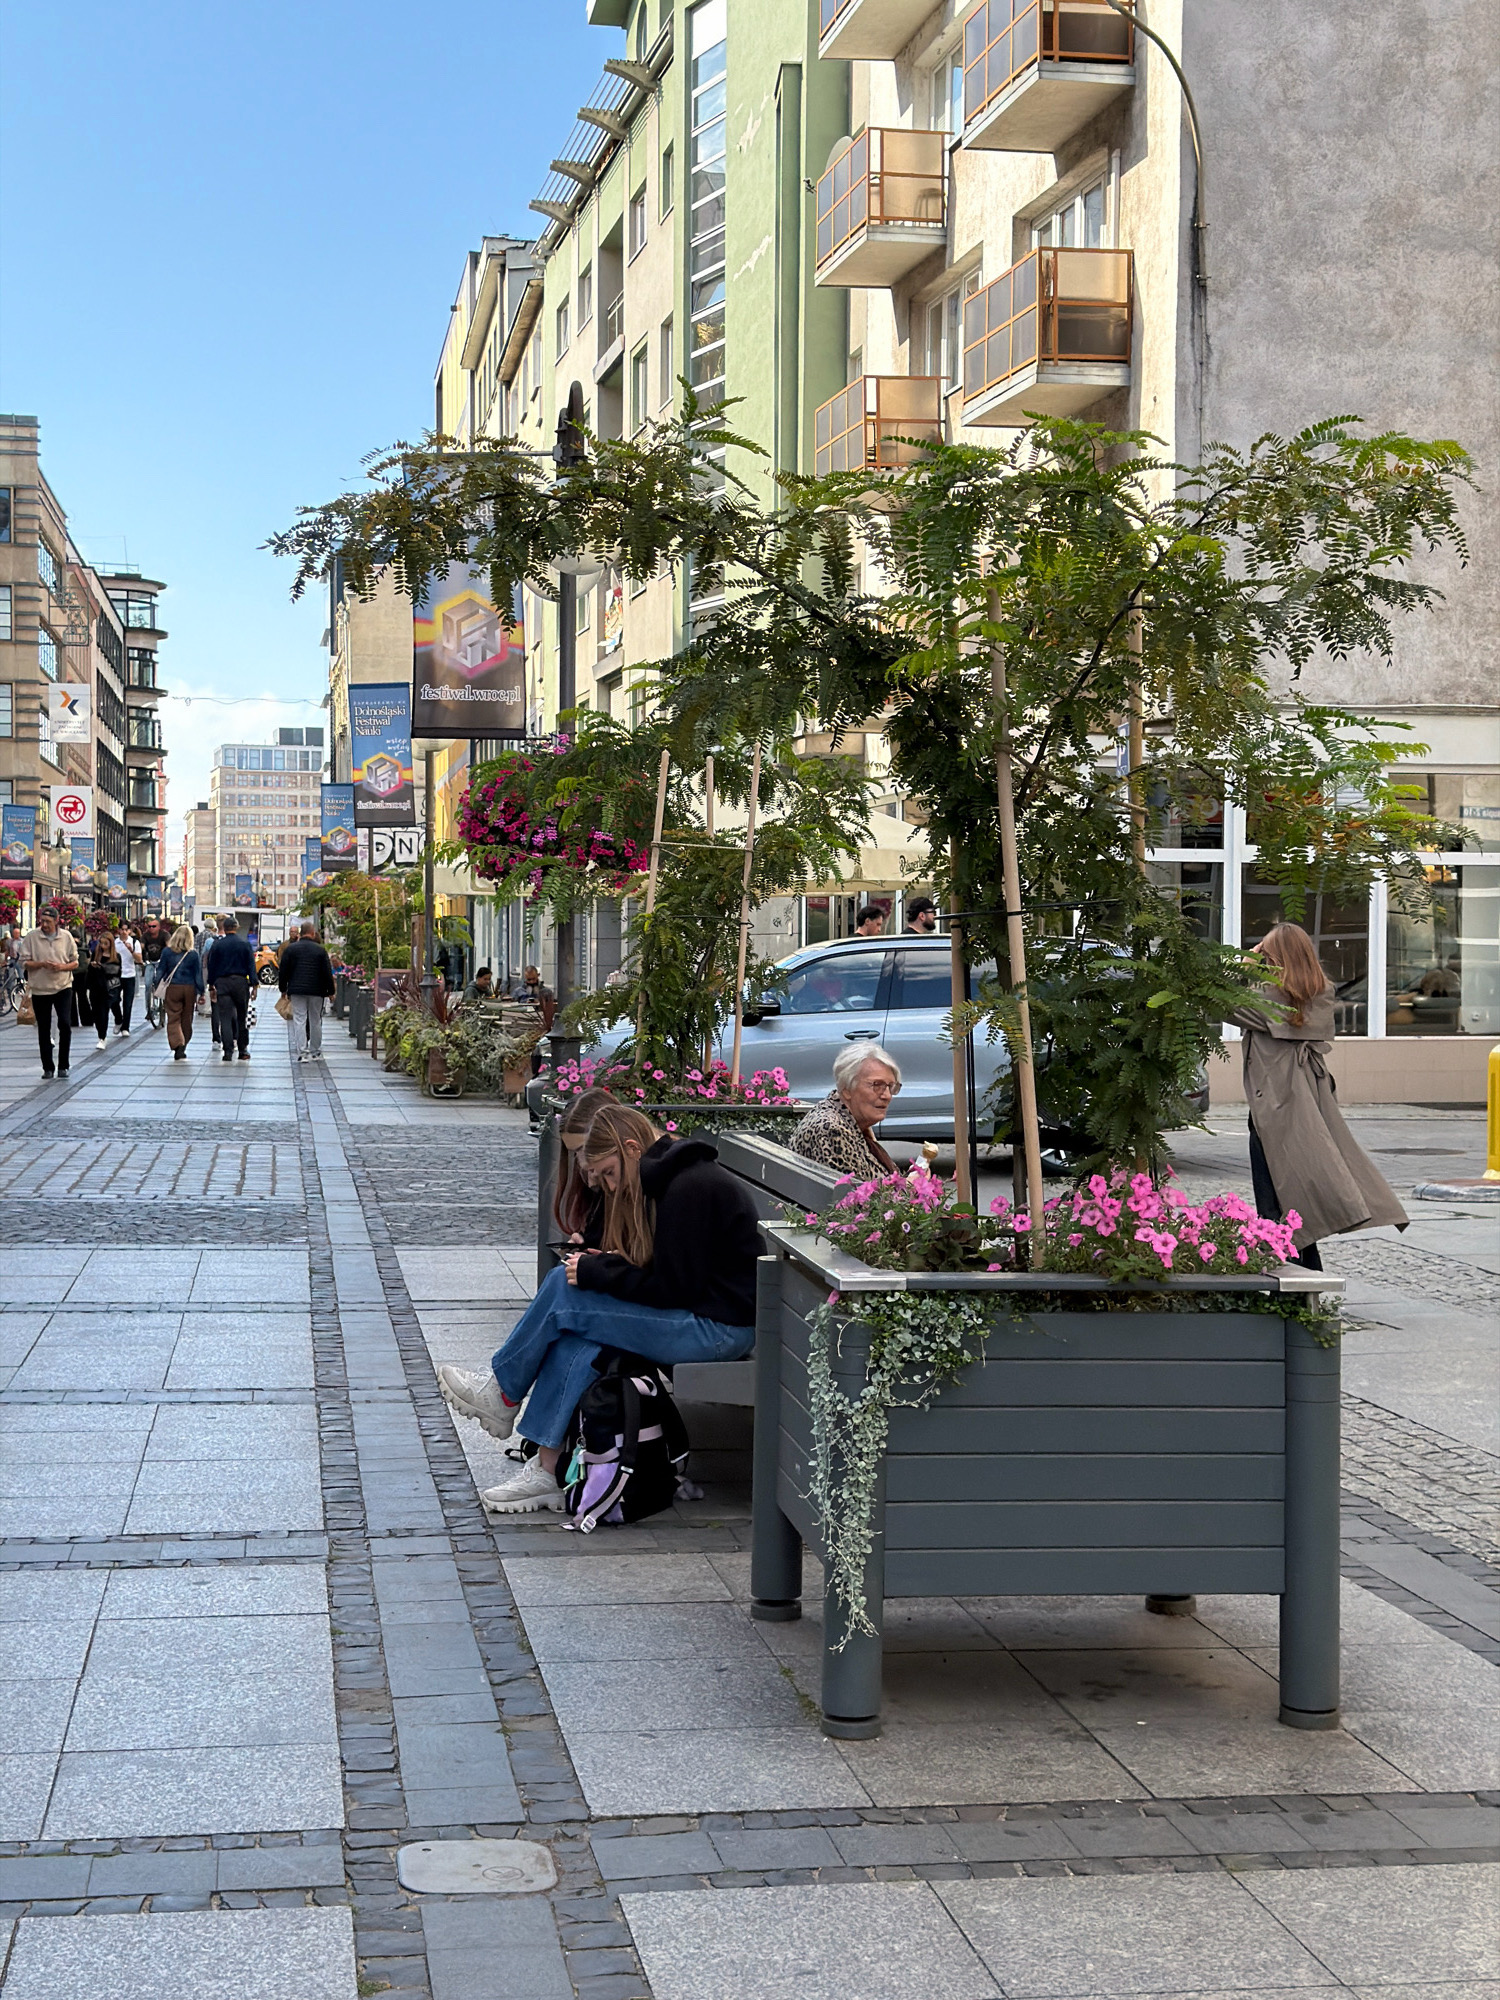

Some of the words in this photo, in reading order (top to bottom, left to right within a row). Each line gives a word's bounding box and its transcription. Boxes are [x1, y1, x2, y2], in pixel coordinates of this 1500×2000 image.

[420, 683, 521, 705] festiwal.wroc.pl
[354, 705, 406, 718] Dolnośląski
[354, 715, 391, 726] Festiwal
[355, 726, 381, 736] Nauki
